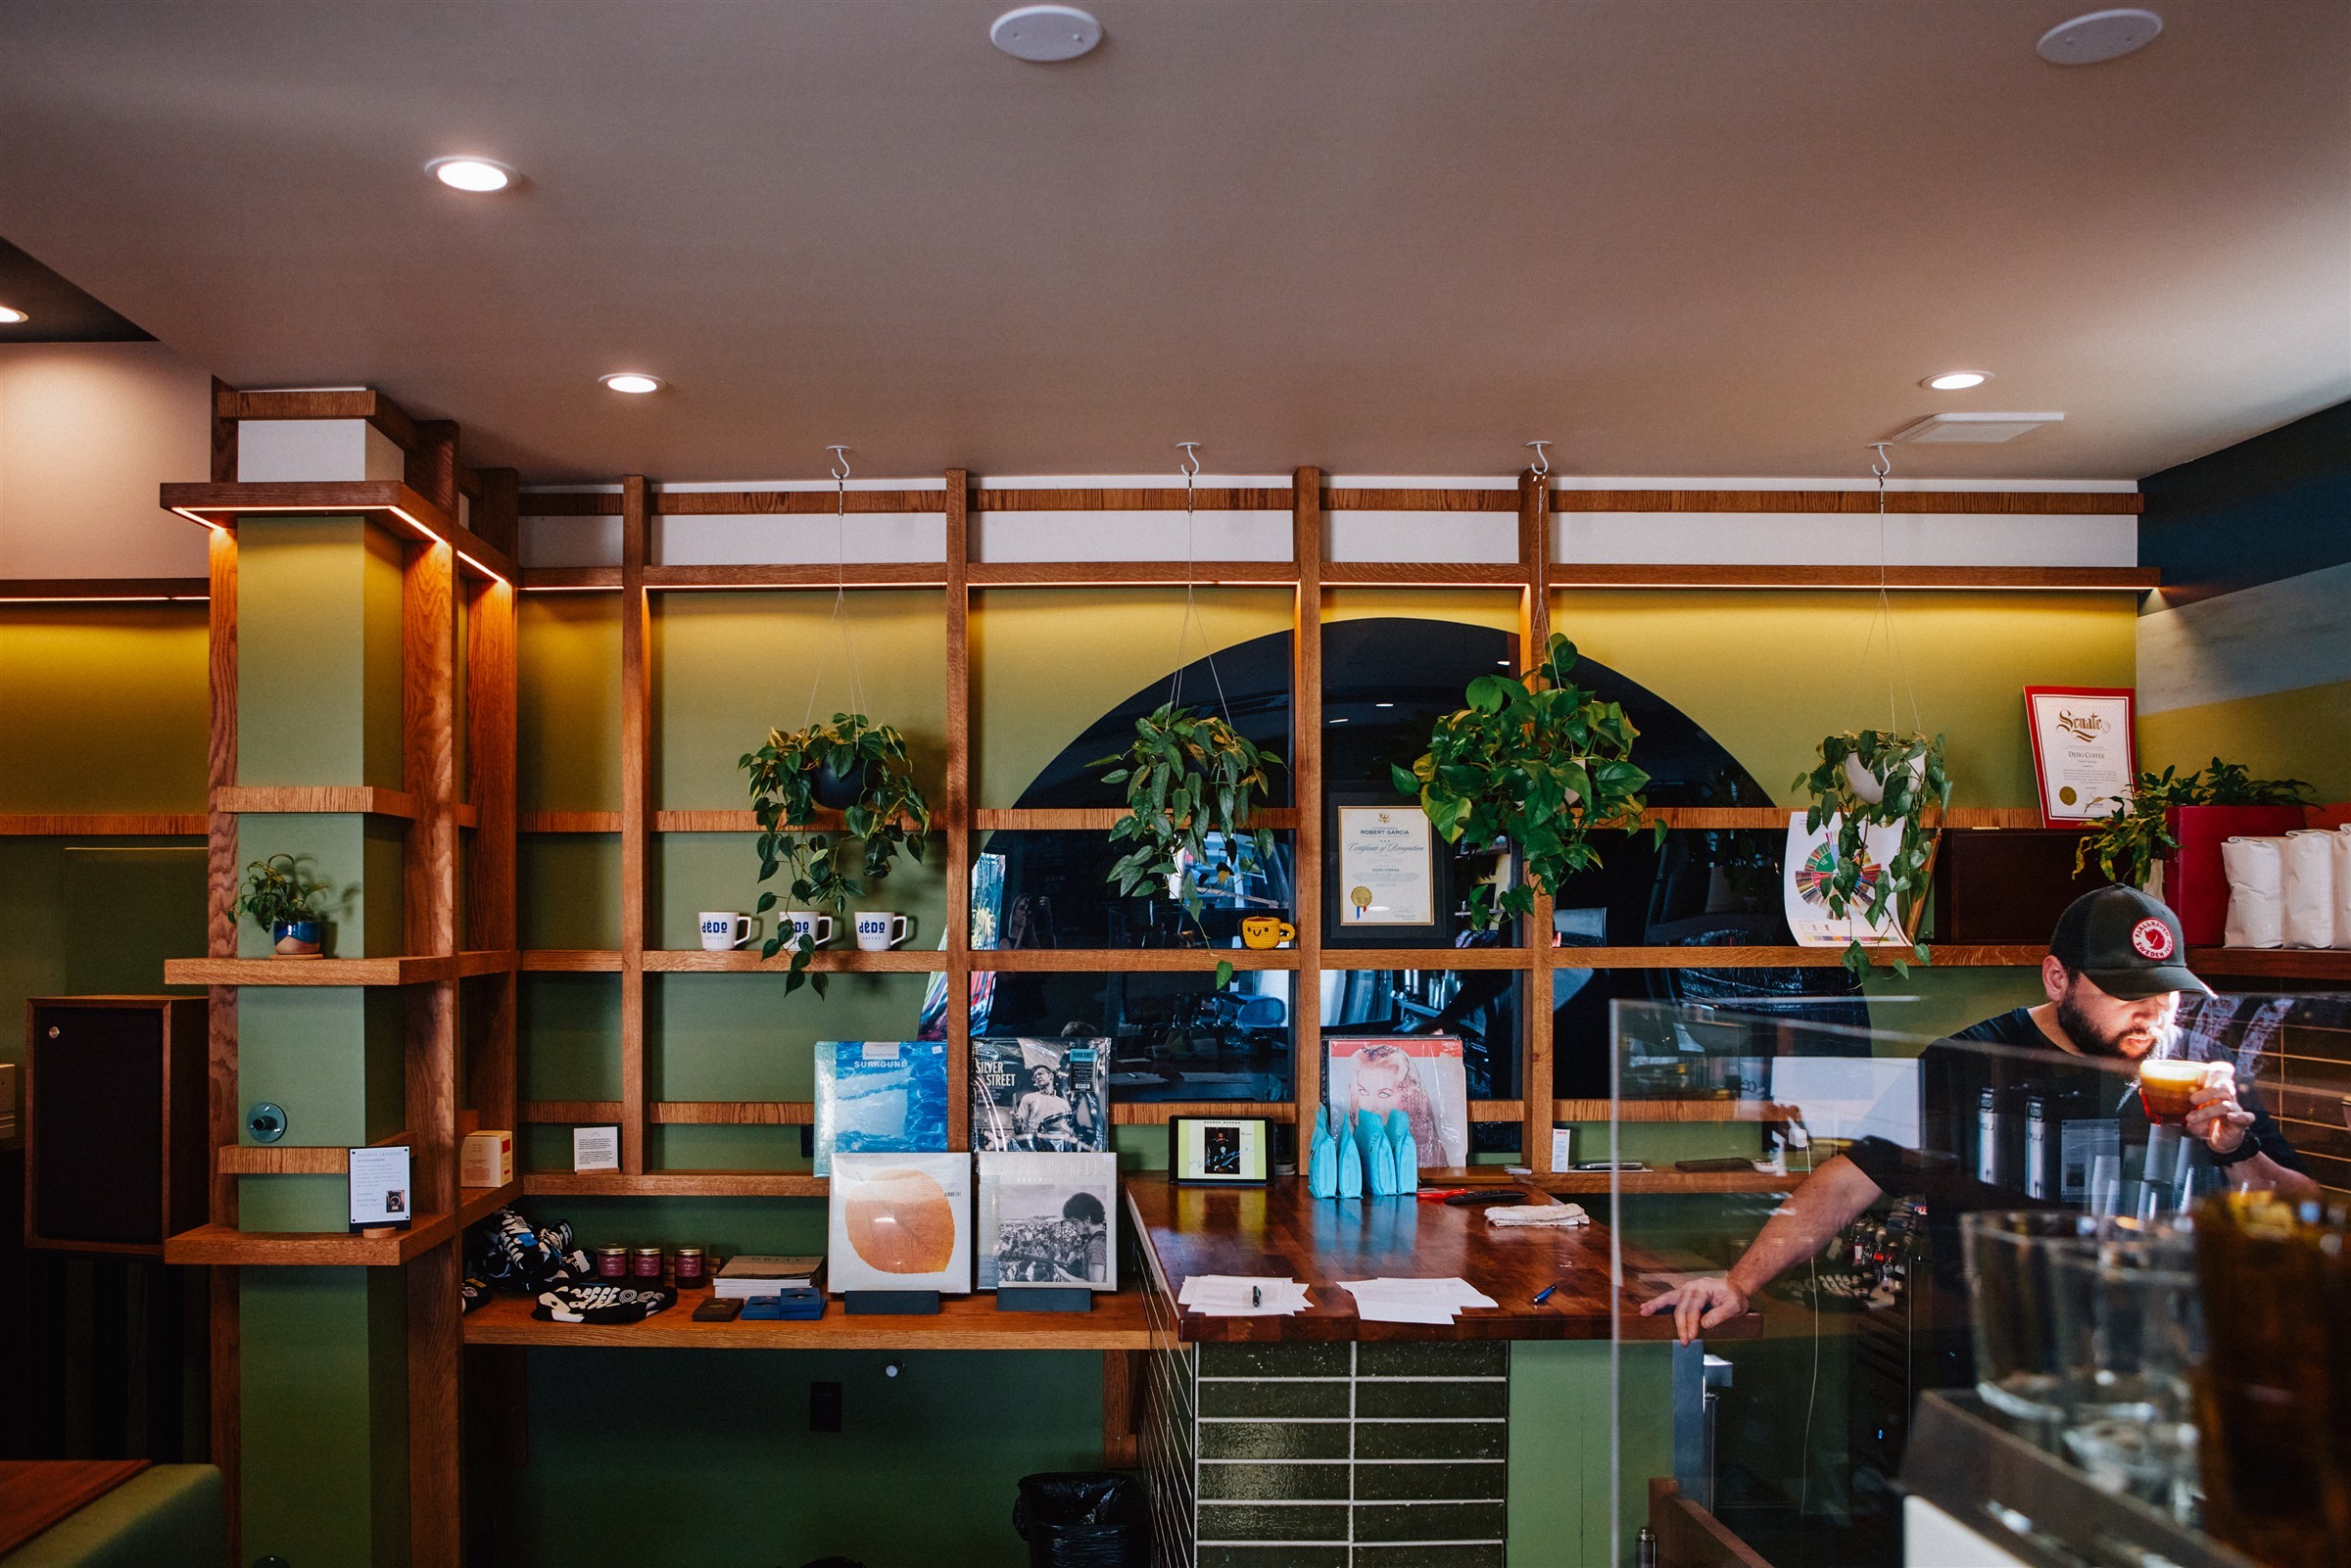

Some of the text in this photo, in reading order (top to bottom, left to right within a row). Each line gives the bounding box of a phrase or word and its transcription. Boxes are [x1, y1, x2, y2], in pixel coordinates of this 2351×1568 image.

[2056, 709, 2111, 742] Senate
[1348, 842, 1379, 856] Certificate
[1387, 842, 1424, 855] Recognition
[2135, 941, 2165, 957] SWEDEN
[853, 1060, 908, 1069] SURROUND
[976, 1061, 1004, 1074] SILVER
[985, 1073, 1016, 1086] STREET
